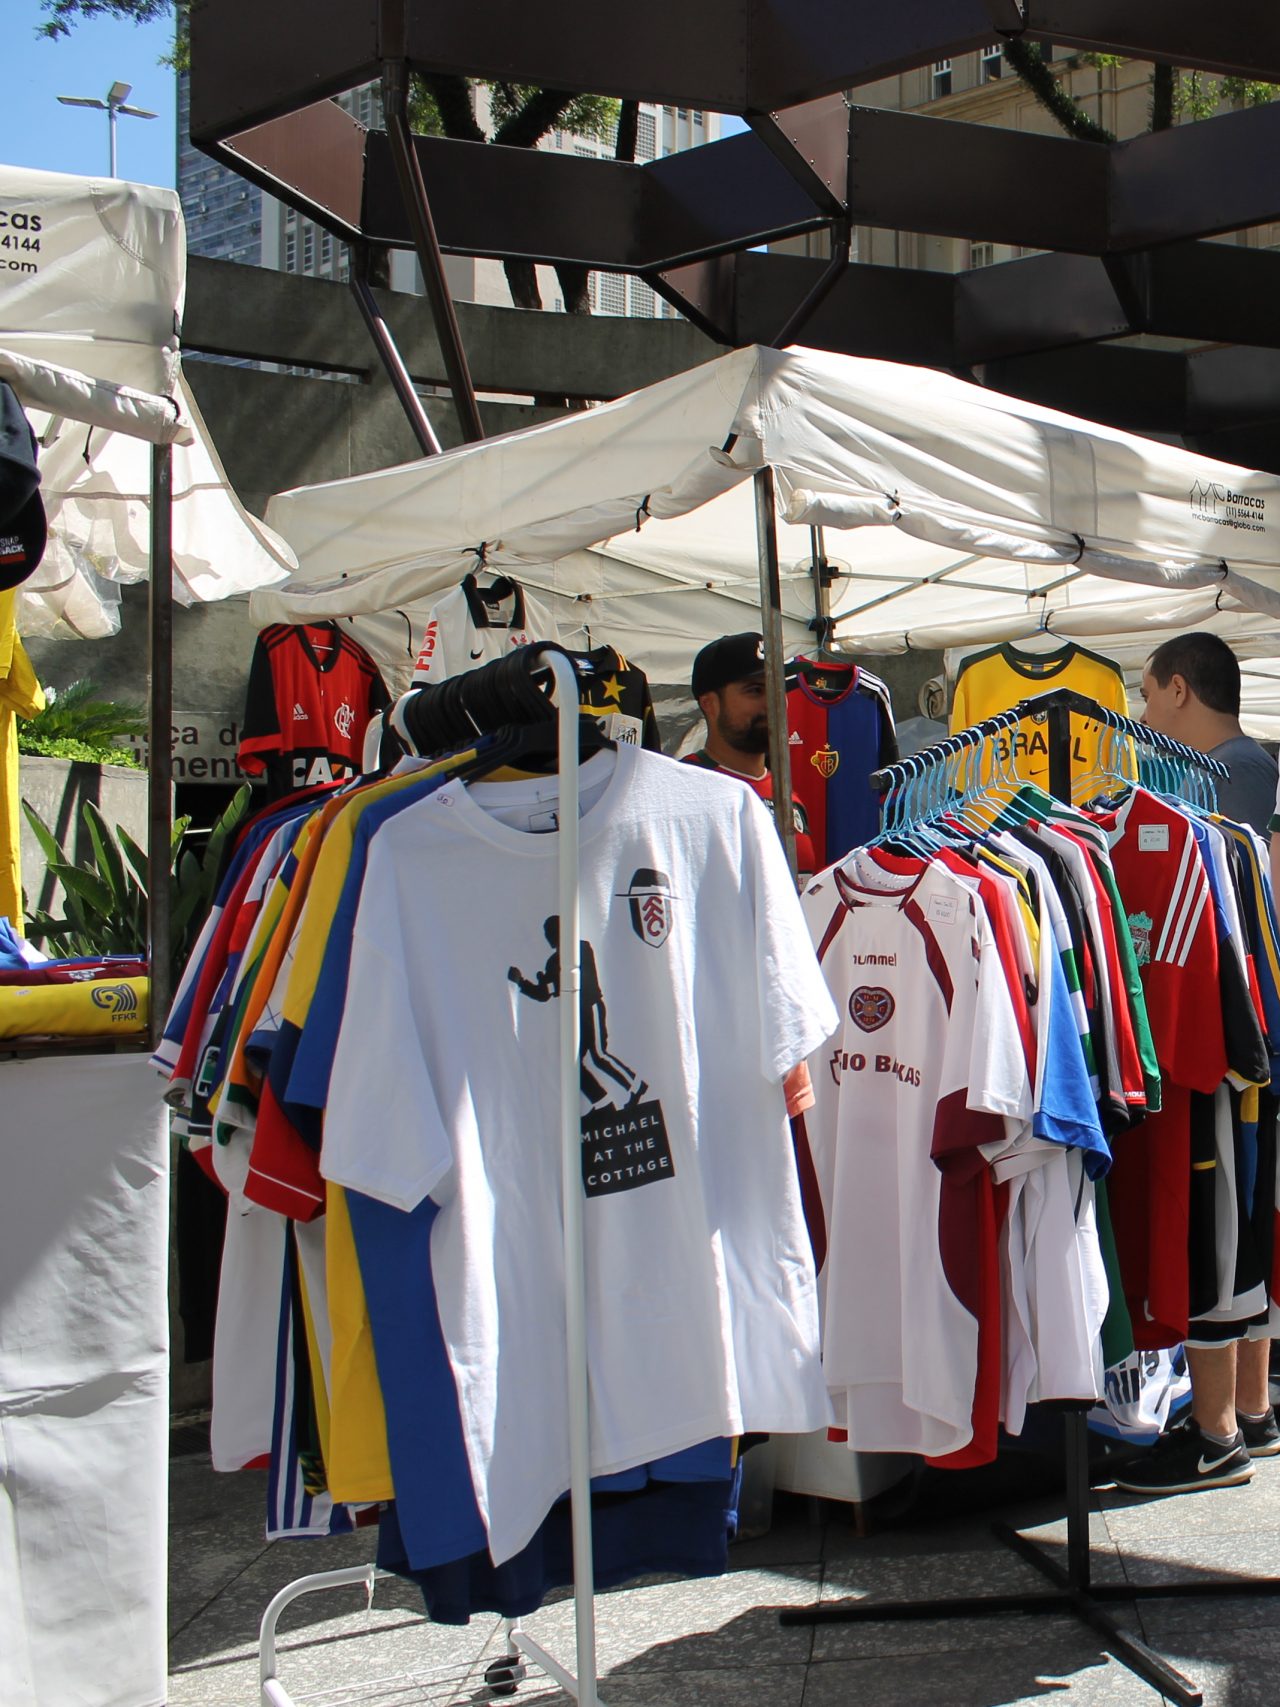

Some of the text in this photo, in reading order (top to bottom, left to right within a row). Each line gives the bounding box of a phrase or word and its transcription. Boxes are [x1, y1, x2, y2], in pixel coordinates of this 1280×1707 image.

[1226, 506, 1237, 518] (11)
[1227, 490, 1265, 509] Barracas
[642, 896, 665, 937] FFC
[581, 1115, 659, 1143] MICHAEL
[594, 1137, 655, 1163] AT THE
[587, 1156, 669, 1186] COTTAGE
